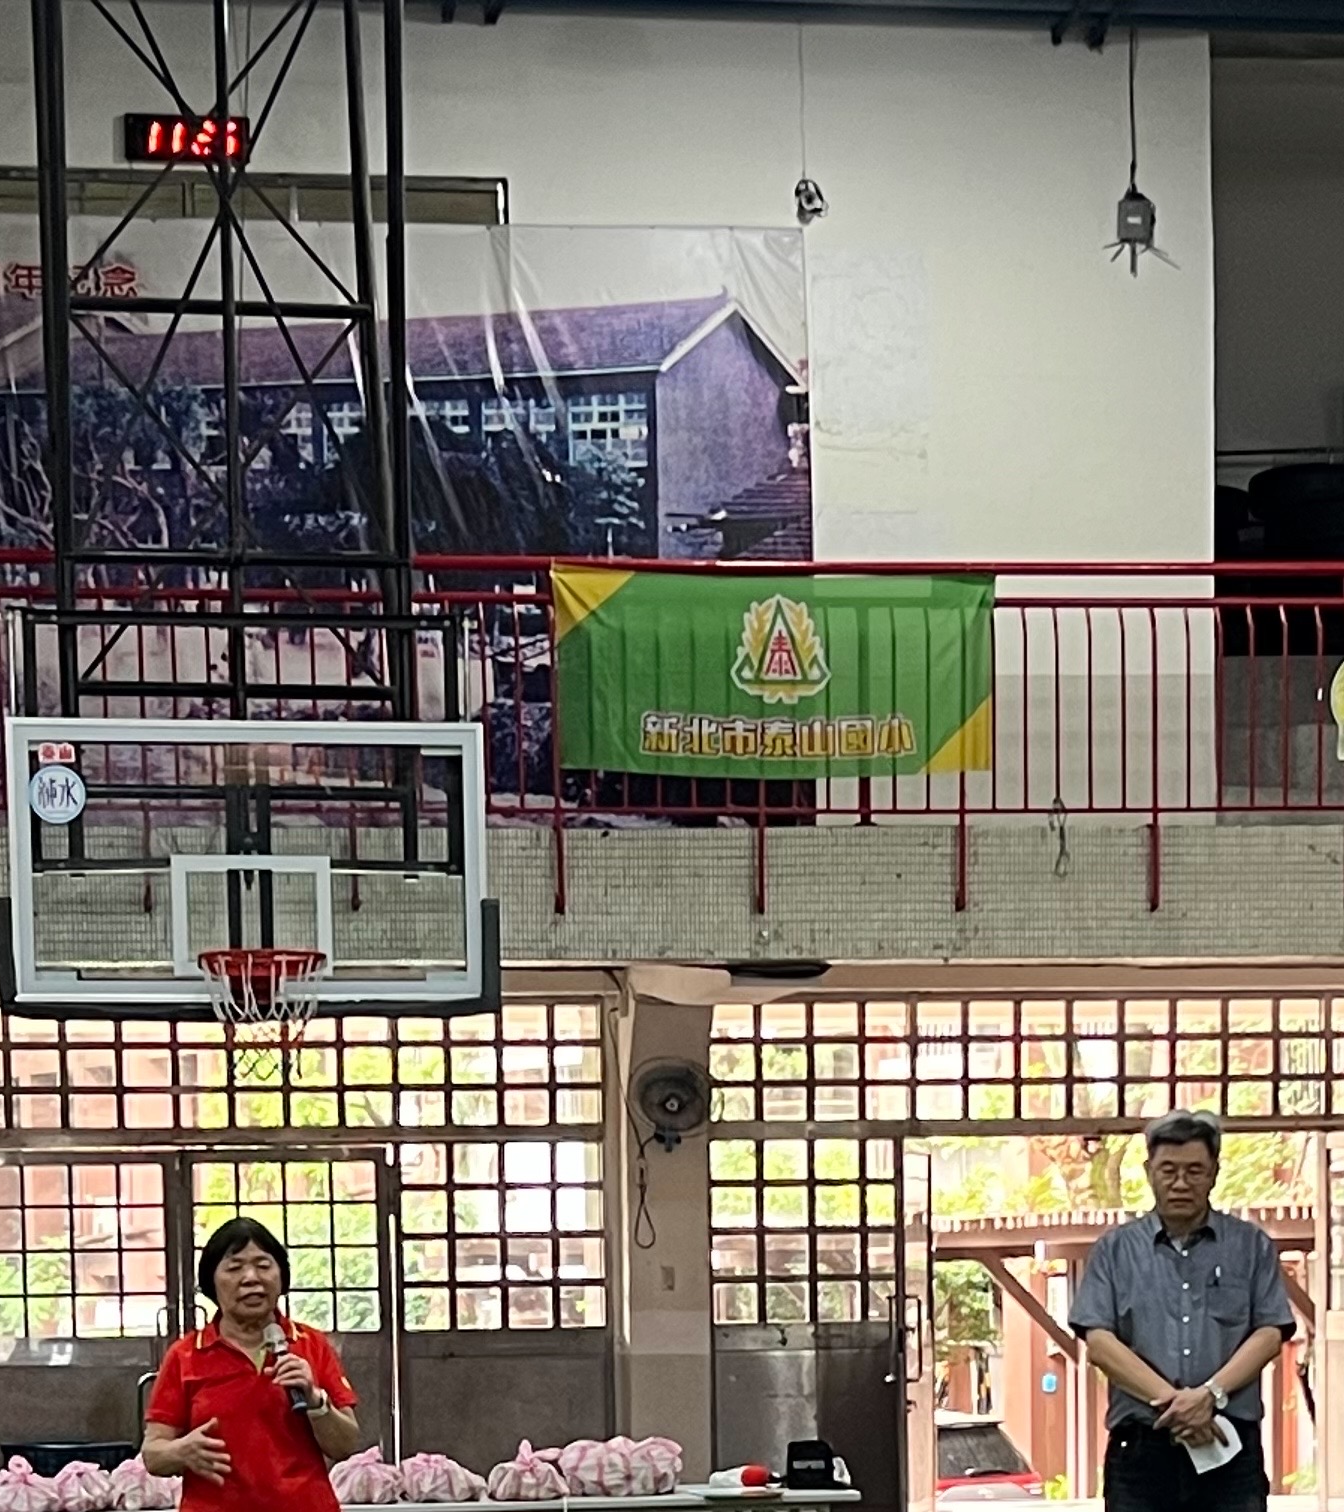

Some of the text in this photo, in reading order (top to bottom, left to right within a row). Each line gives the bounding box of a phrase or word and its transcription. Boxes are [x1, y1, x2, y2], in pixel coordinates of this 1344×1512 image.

[641, 711, 915, 759] 新北市泰山國小
